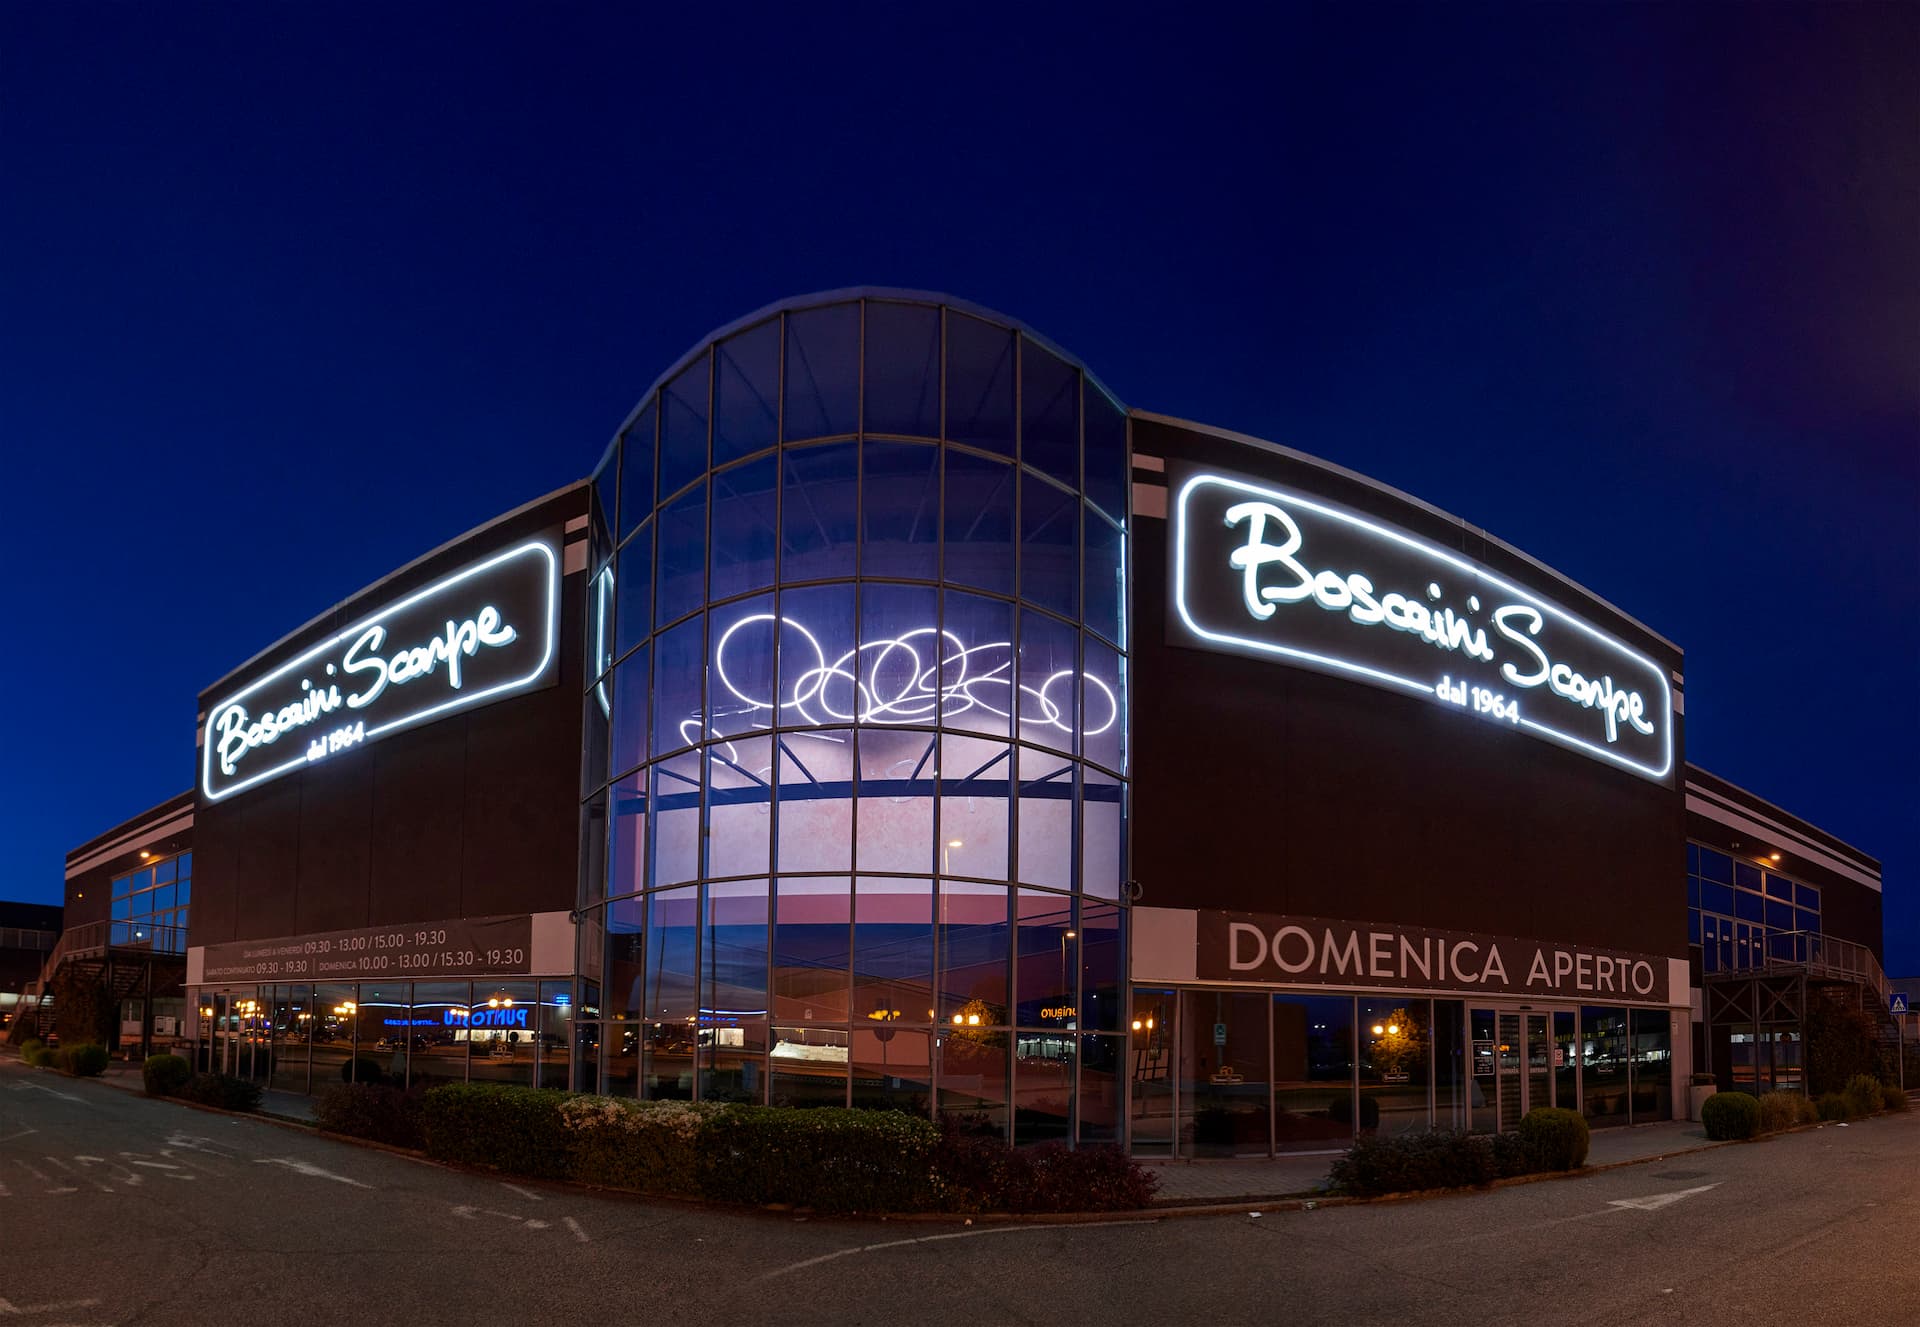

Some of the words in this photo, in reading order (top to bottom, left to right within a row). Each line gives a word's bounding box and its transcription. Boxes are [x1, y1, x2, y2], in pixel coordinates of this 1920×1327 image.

[1223, 501, 1494, 661] Boscaini
[1494, 605, 1654, 744] Scarpe
[216, 662, 342, 776] Boscaini
[343, 605, 518, 710] Scarpe
[1435, 676, 1467, 705] dal
[1471, 687, 1521, 724] 1964
[306, 739, 327, 762] dal
[329, 721, 365, 755] 1964
[304, 940, 330, 954] 09.30
[339, 937, 366, 952] 13.00
[374, 933, 404, 949] 15.00
[415, 929, 446, 946] 19.30
[319, 961, 356, 971] DOMENICA
[359, 956, 388, 970] 10.00
[398, 953, 430, 968] 13.00
[440, 950, 474, 967] 15.30
[486, 948, 524, 965] 19.30
[1228, 921, 1509, 985] DOMENICA
[1526, 948, 1655, 995] APERTO
[256, 962, 278, 974] 09.30
[285, 960, 308, 973] 19.30
